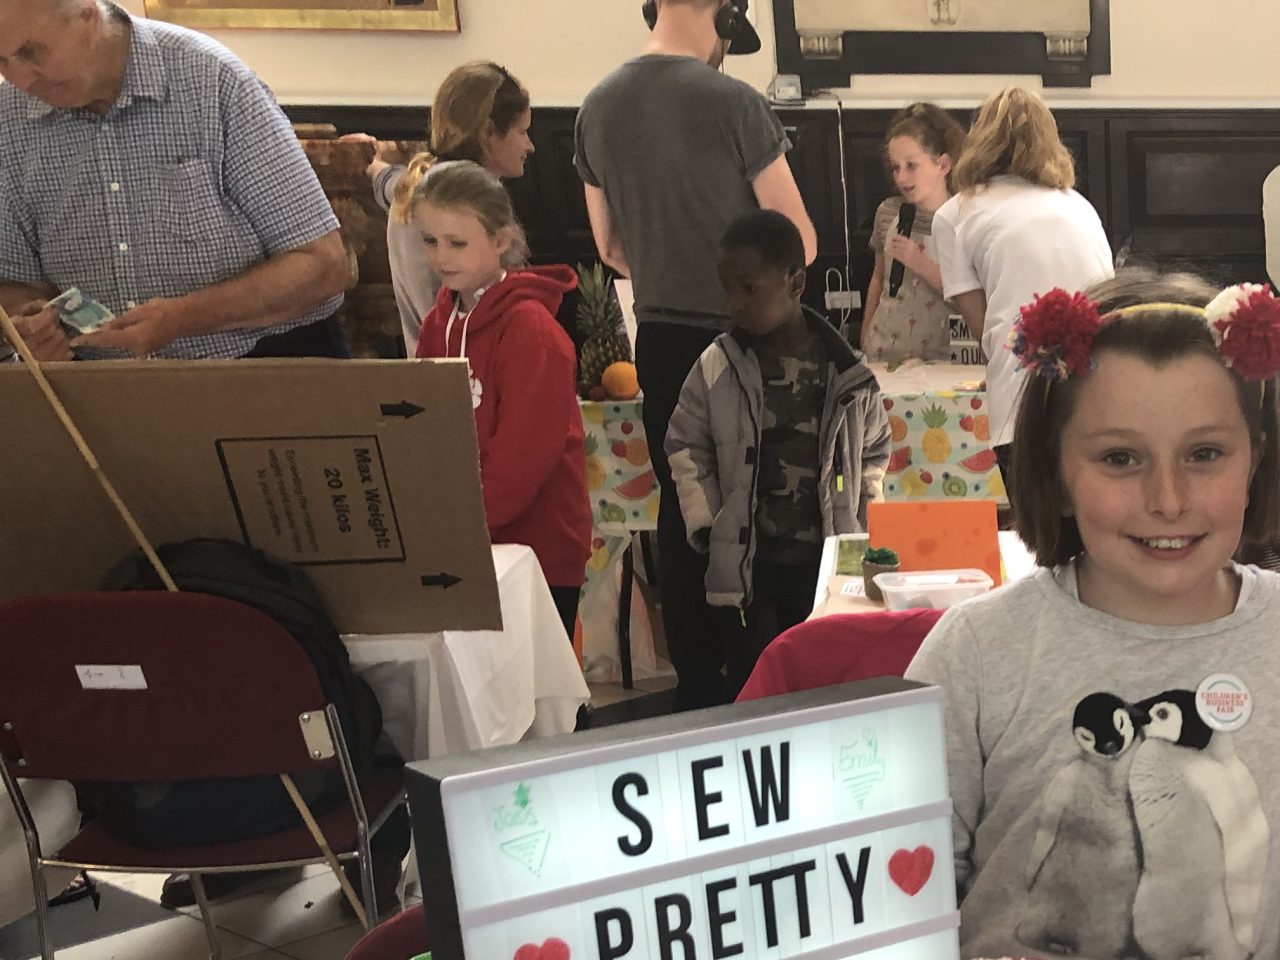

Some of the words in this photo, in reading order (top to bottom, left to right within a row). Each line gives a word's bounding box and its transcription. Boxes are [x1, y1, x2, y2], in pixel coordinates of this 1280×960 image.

[951, 322, 970, 339] SM
[324, 468, 343, 489] 20
[354, 448, 373, 484] Max
[364, 487, 391, 549] Weight:
[330, 494, 351, 534] kilos
[611, 741, 791, 857] SEW
